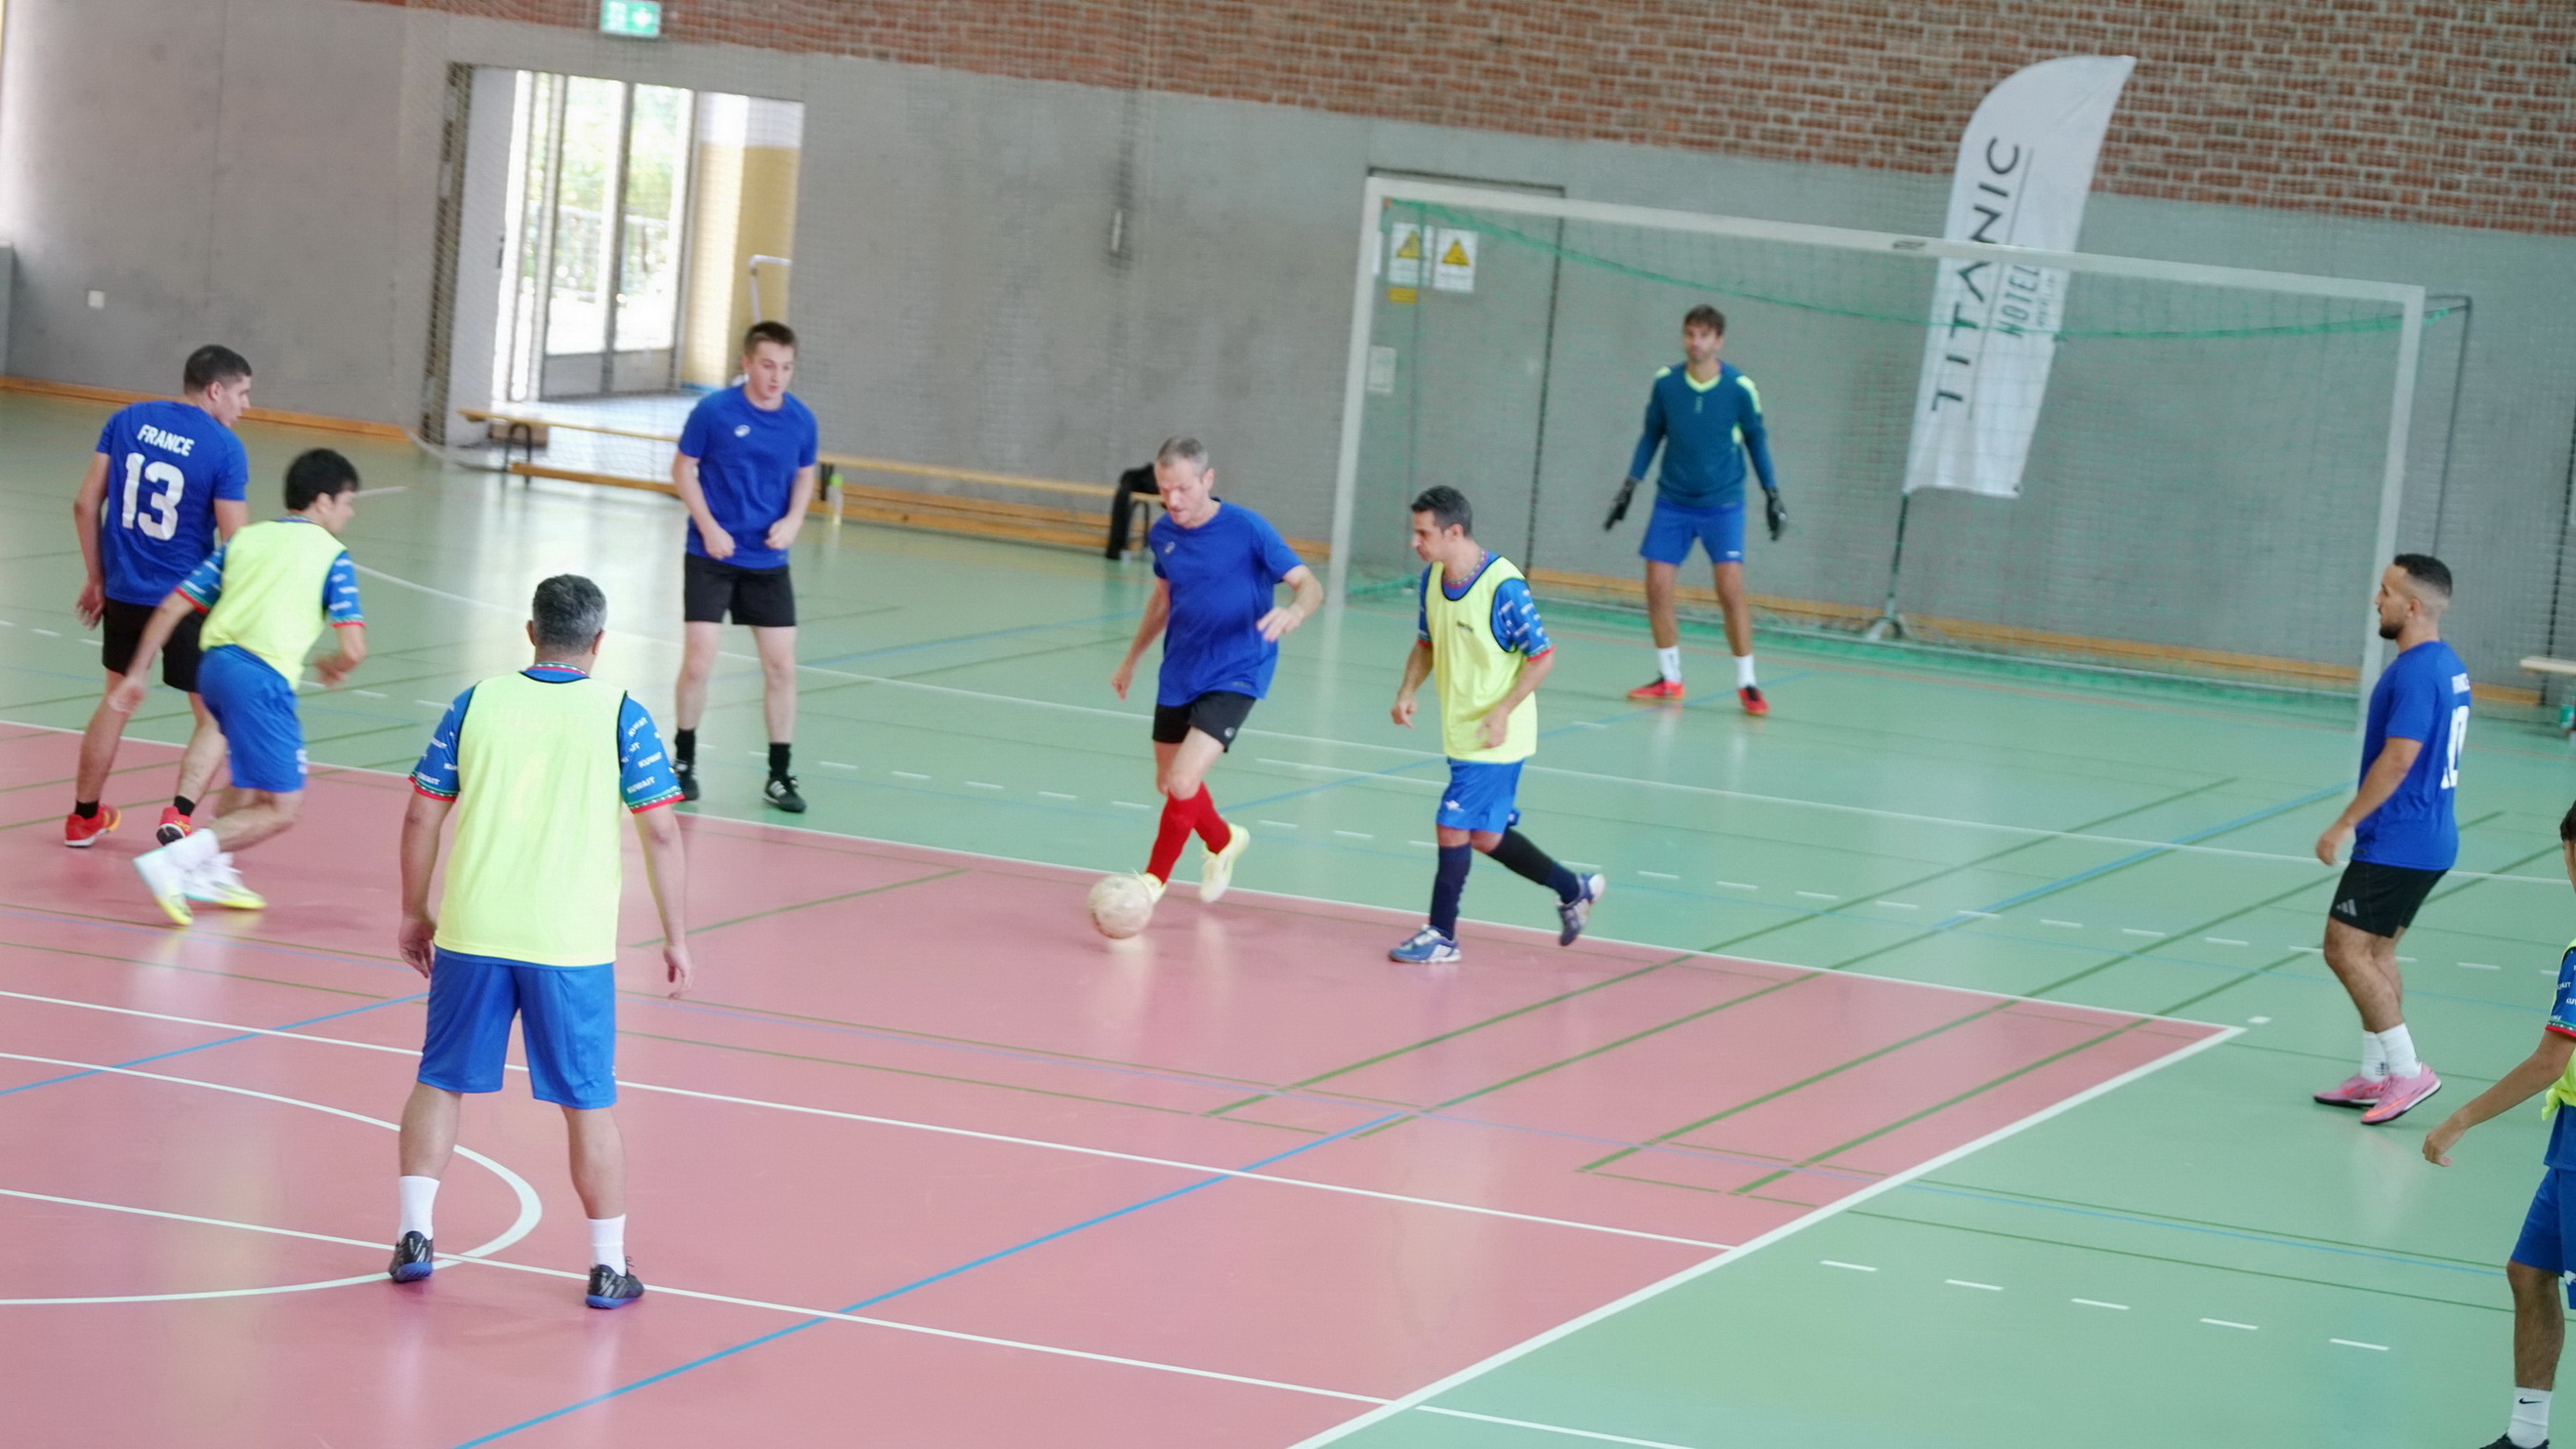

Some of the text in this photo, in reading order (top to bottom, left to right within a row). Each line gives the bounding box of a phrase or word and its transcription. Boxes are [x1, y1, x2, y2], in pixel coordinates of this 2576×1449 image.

[1931, 136, 2020, 411] TITANIC
[1995, 245, 2041, 338] HOTEL
[137, 424, 195, 457] FRANCE
[122, 452, 185, 541] 13
